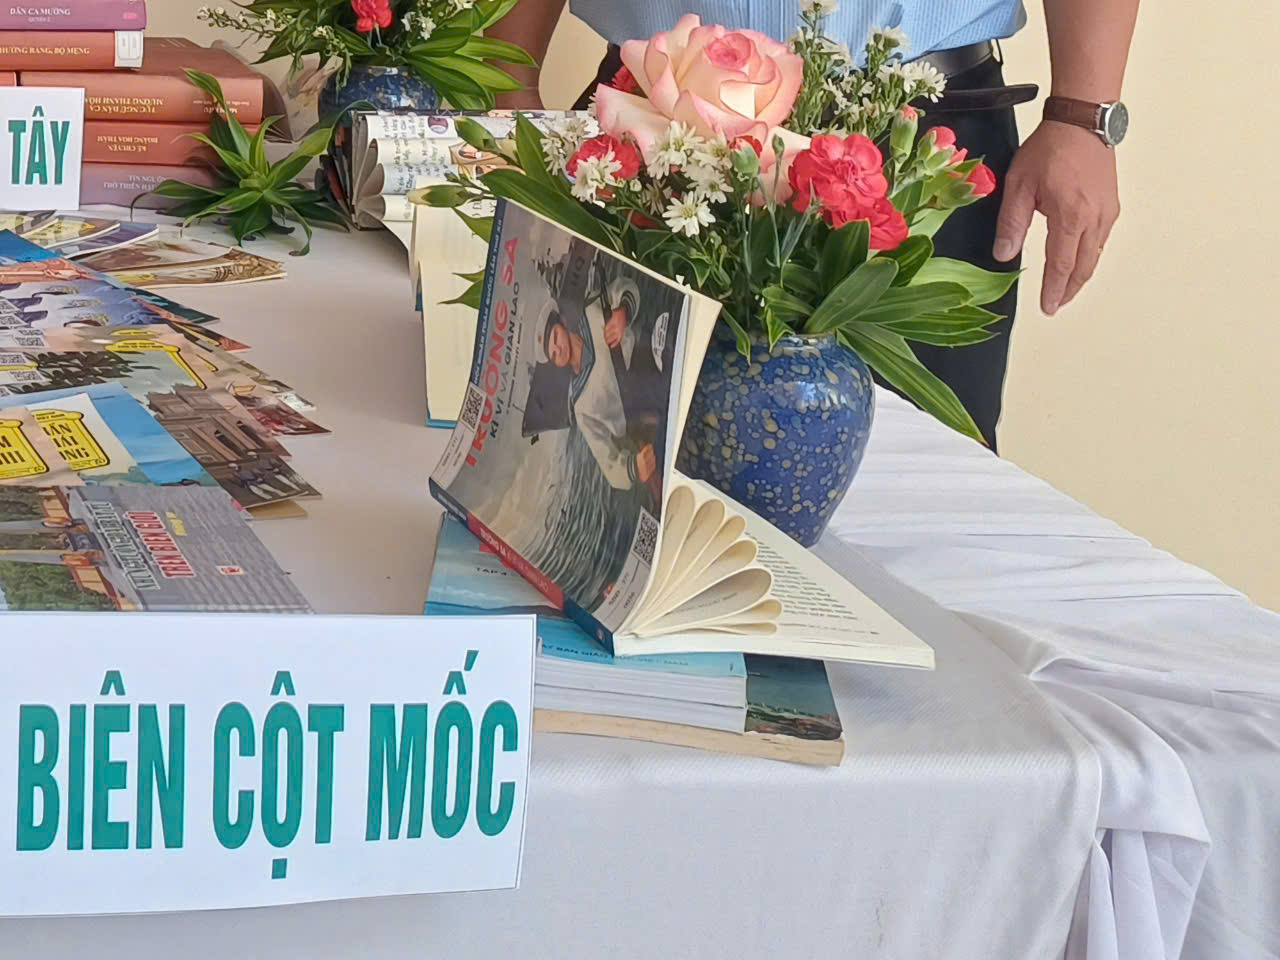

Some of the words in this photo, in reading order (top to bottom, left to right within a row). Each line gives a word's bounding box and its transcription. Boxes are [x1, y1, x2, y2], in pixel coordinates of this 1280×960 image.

[8, 106, 71, 185] TÂY
[501, 237, 519, 287] SA
[509, 281, 520, 317] LAO
[503, 320, 517, 365] GIAN
[16, 670, 186, 851] BIÊN
[213, 670, 345, 879] CỘT
[365, 650, 520, 842] MỐC
